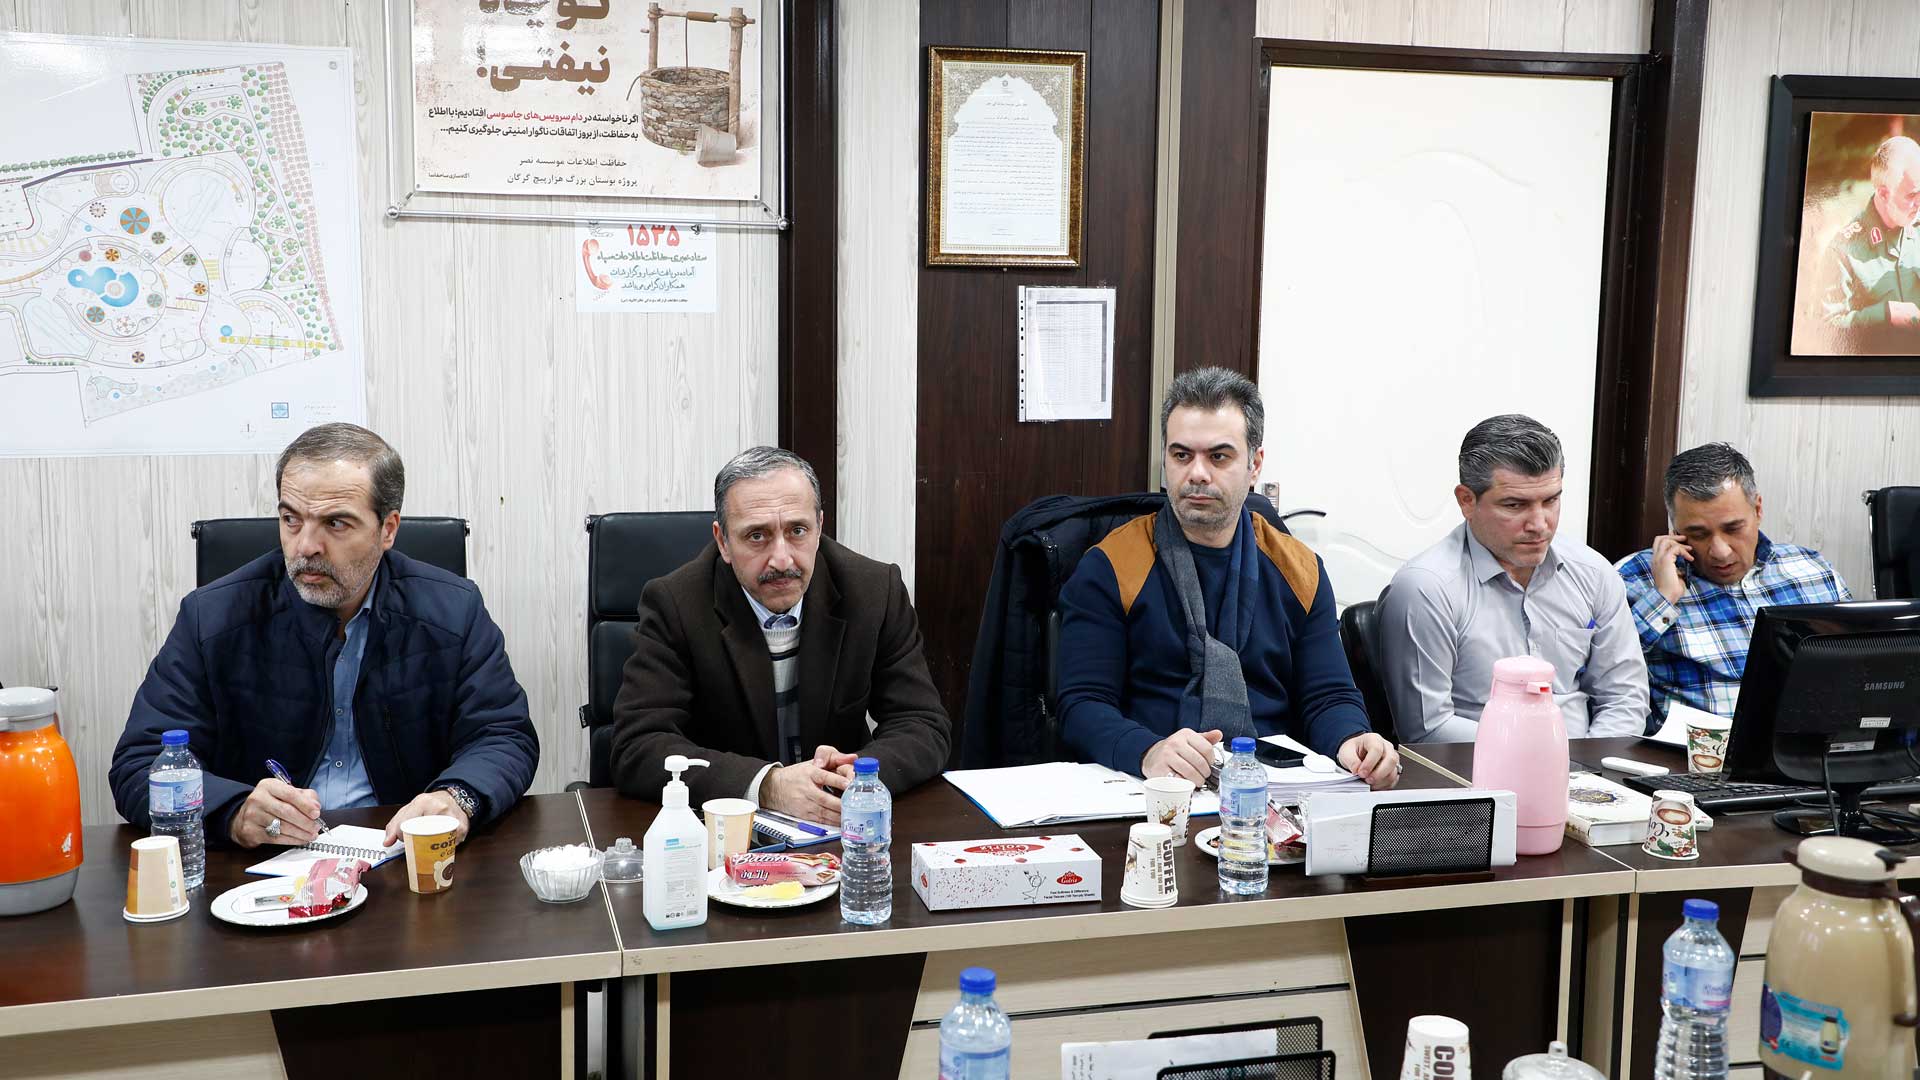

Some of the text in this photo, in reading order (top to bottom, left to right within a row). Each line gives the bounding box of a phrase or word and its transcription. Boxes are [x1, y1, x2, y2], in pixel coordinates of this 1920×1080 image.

[487, 110, 522, 120] جاسوسی
[571, 112, 583, 123] دام
[583, 114, 592, 123] در
[627, 114, 639, 125] اگر
[468, 123, 501, 136] جلوگیری
[502, 126, 528, 137] امنیتی
[528, 127, 549, 138] ناگوار
[549, 126, 578, 137] اتفاقات
[577, 128, 593, 139] بروز
[630, 131, 639, 141] به
[567, 157, 598, 166] اطلاعات
[600, 158, 627, 167] حفاظت
[589, 175, 616, 186] بوستان
[1864, 681, 1905, 691] SAMSUNG
[1163, 839, 1175, 895] COFFEE
